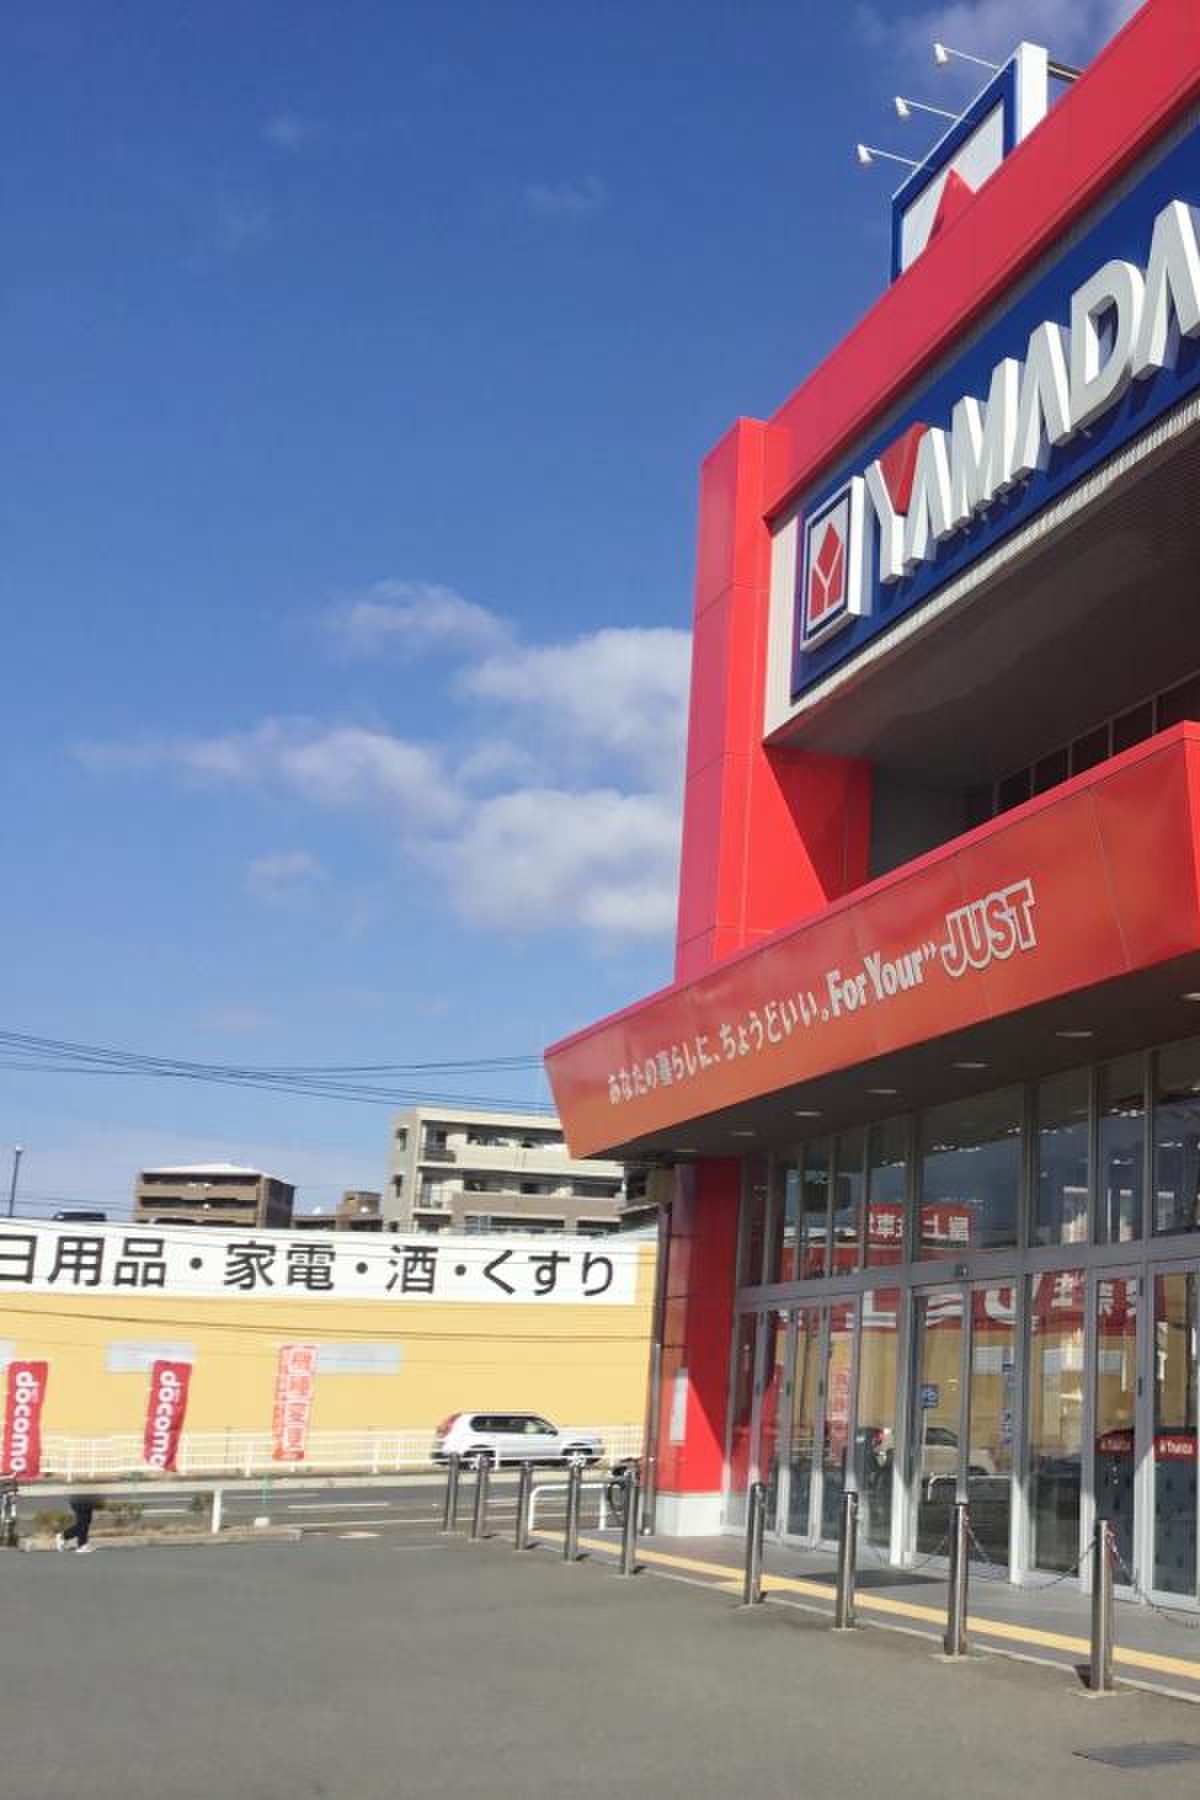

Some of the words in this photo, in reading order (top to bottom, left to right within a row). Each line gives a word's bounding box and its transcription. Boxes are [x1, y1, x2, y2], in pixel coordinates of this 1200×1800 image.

[941, 877, 1038, 977] JUST
[10, 1371, 40, 1472] docomo
[150, 1370, 183, 1467] docomo
